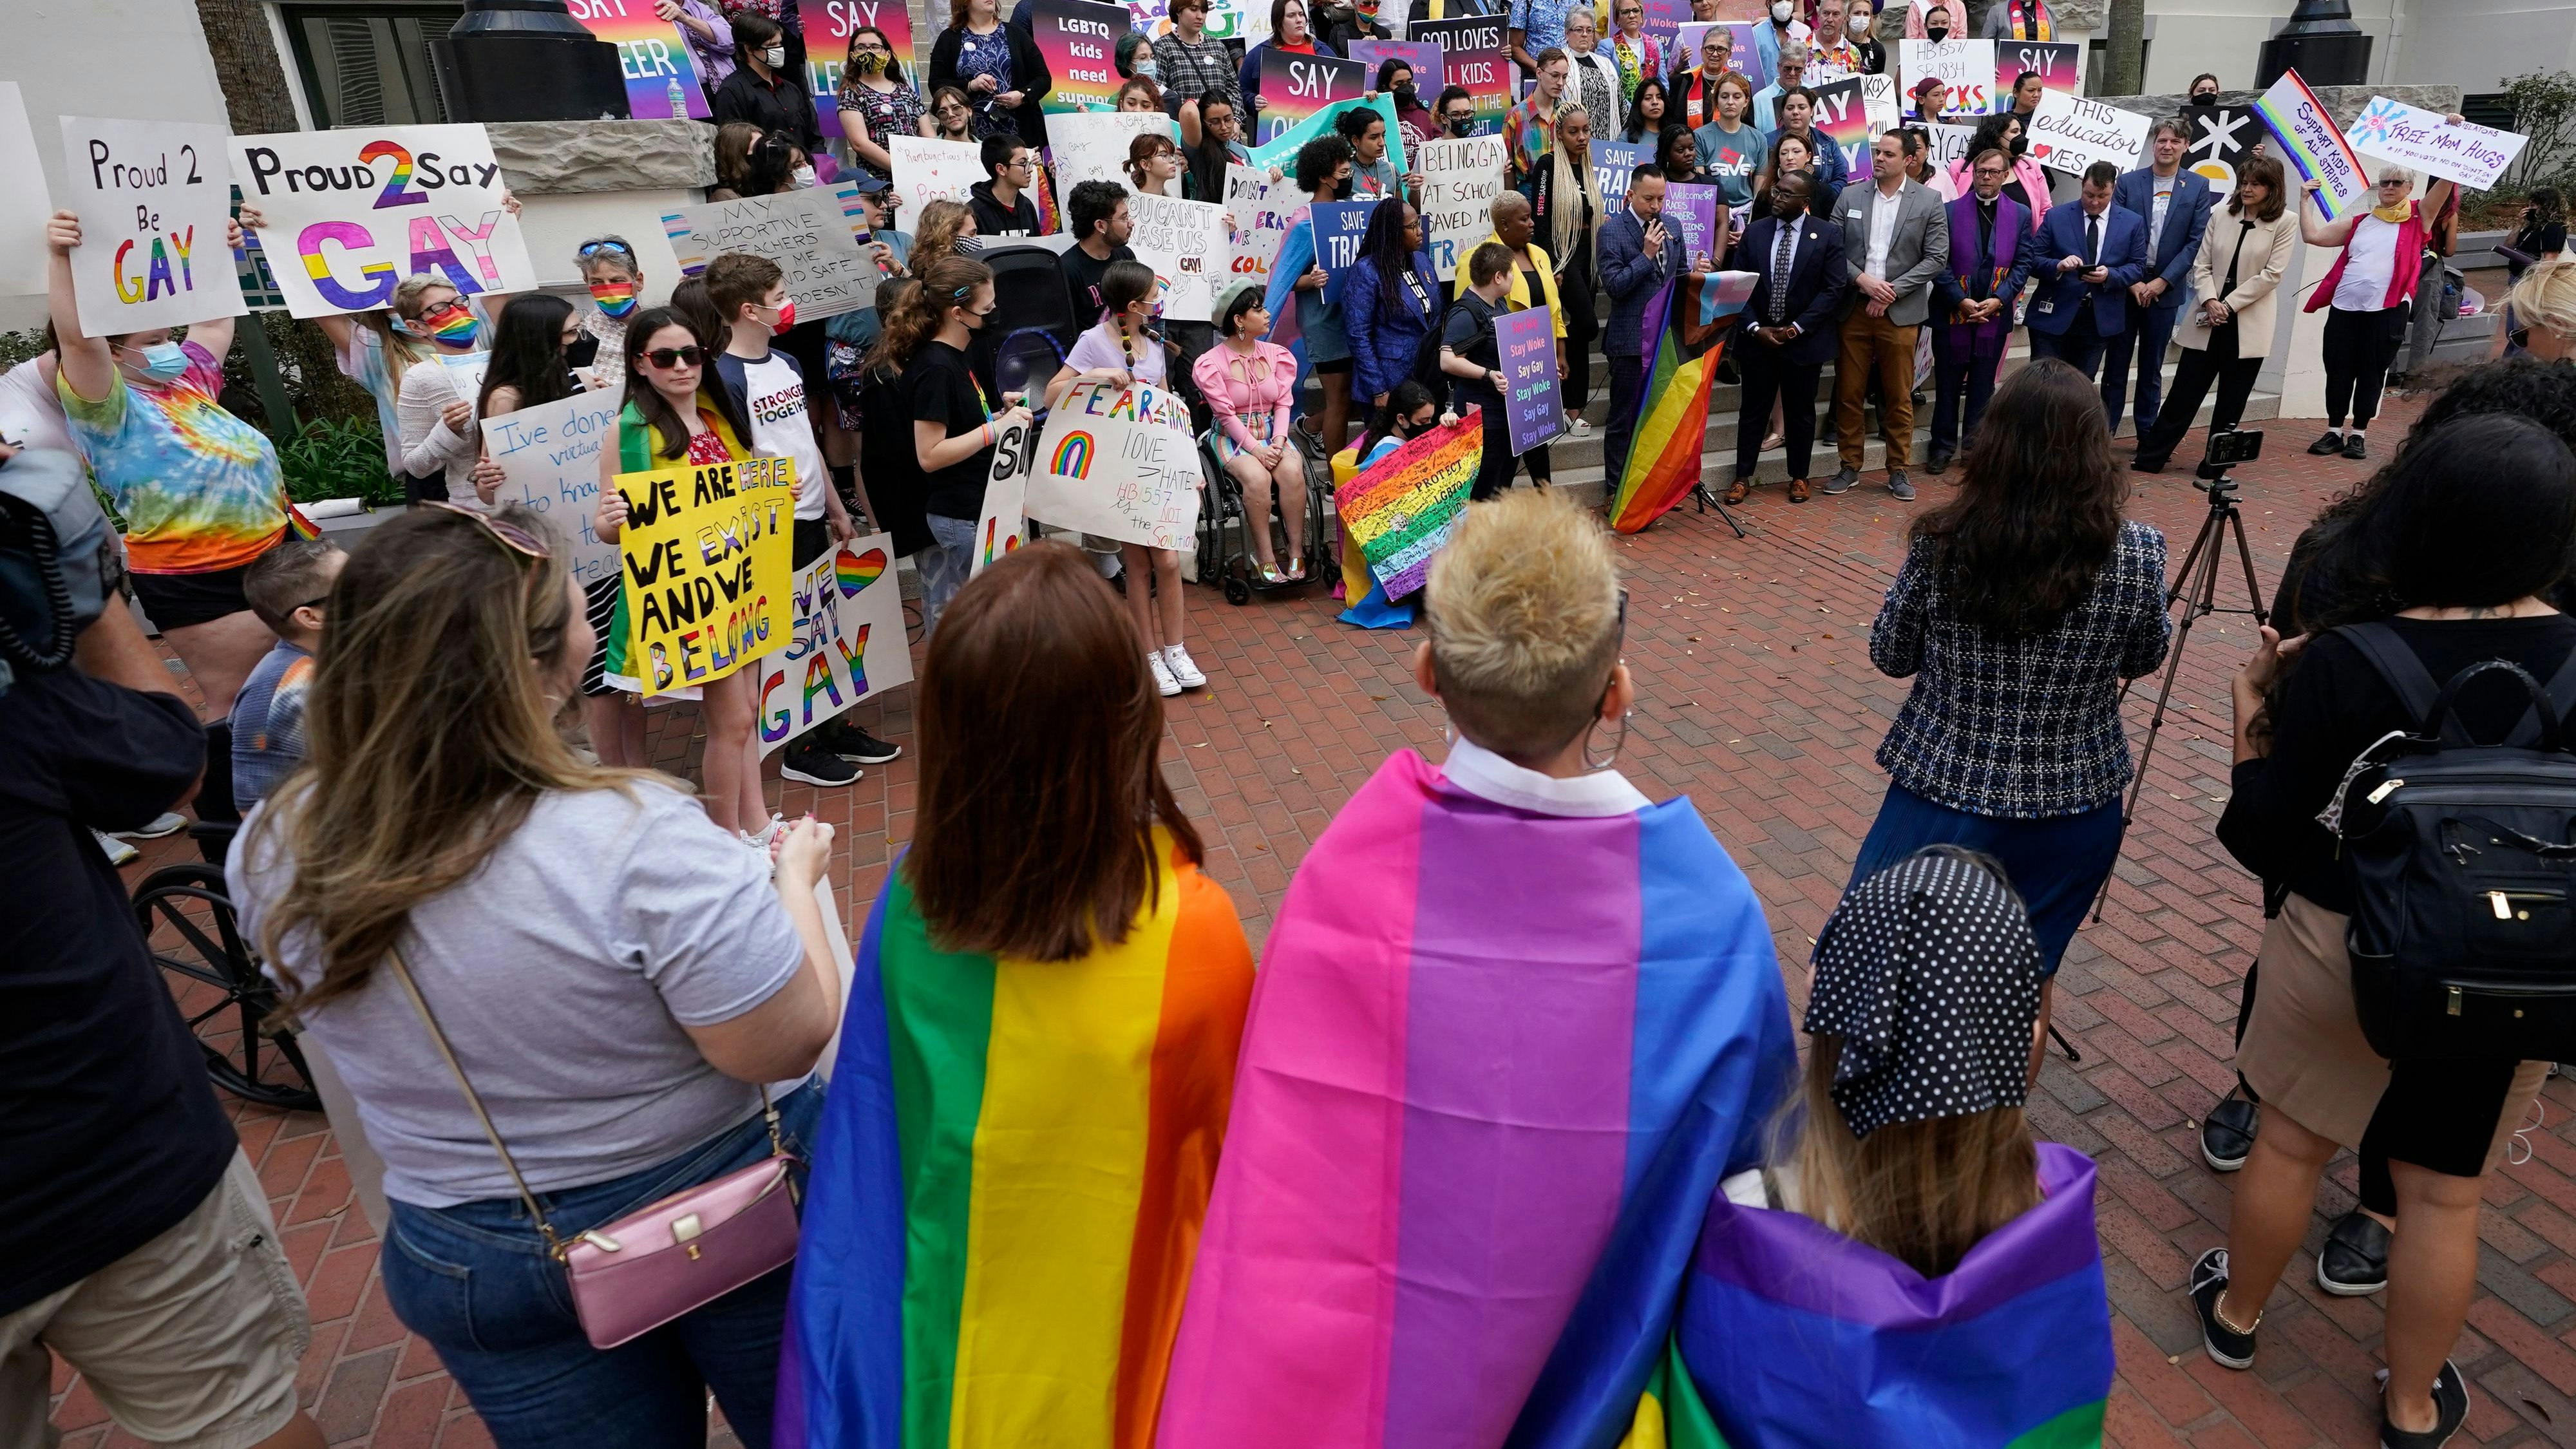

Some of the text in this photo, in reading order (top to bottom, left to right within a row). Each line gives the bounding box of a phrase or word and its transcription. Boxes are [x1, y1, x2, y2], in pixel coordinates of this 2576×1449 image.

[827, 1, 878, 37] SAY
[1058, 17, 1110, 40] LGBTQ
[1070, 42, 1103, 60] kids
[1375, 45, 1419, 59] Say Gay
[1455, 26, 1499, 52] LOVES
[616, 39, 678, 79] EER
[1461, 61, 1495, 84] KIDS,
[2018, 48, 2058, 77] SAY
[1069, 67, 1108, 84] need
[1288, 61, 1339, 100] SAY
[1057, 90, 1110, 104] suppor
[1482, 93, 1502, 109] THE
[1813, 90, 1852, 127] AY
[1905, 85, 1987, 116] SCKS
[2071, 97, 2116, 125] THIS
[2032, 115, 2141, 155] educator
[2445, 120, 2499, 137] GISLATORS
[1425, 141, 1504, 172] BEING GAY
[1605, 149, 1635, 167] SAVE
[2388, 120, 2505, 169] FREE MOM HUGS
[2419, 153, 2438, 162] VOTE
[89, 139, 202, 189] Proud 2
[358, 140, 430, 209] 2
[2295, 124, 2348, 198] OF ALL STRIPES
[2328, 149, 2350, 176] KIDS
[916, 183, 969, 205] Prote
[1422, 184, 1446, 205] AT
[1665, 200, 1688, 210] RACES
[1668, 184, 1704, 200] Welcome
[137, 205, 160, 232] Be
[723, 198, 772, 225] MY
[1127, 194, 1213, 230] OU CAN'T
[1255, 211, 1292, 231] ERAS
[1340, 211, 1367, 231] SAVE
[1425, 208, 1490, 232] SAVED M
[691, 213, 822, 251] SUPPORTIVE
[1131, 225, 1208, 254] RASE US
[1232, 230, 1251, 246] UR
[114, 225, 193, 305] GAY
[297, 211, 504, 310] GAY
[794, 251, 820, 266] ME
[1180, 257, 1202, 273] GAY!
[1231, 255, 1268, 274] COL
[1329, 235, 1365, 269] TRA
[782, 259, 857, 285] ND SAFE
[1512, 316, 1539, 336] Say Gay
[1510, 336, 1546, 358] Stay Woke
[1518, 359, 1544, 379] Say Gay
[753, 383, 803, 413] STRONGE
[1061, 382, 1153, 424] FEAR
[1516, 379, 1551, 402] Stay Woke
[562, 409, 616, 438] done
[756, 398, 807, 426] TOGETHE
[1524, 401, 1549, 422] Say Gay
[1522, 421, 1557, 446] Stay Woke
[1159, 465, 1195, 491] HATE
[1414, 459, 1462, 493] PROTECT
[524, 484, 550, 513] to
[618, 479, 681, 531] WE
[694, 466, 735, 507] ARE
[1130, 515, 1151, 529] the
[1160, 507, 1182, 523] NOT
[625, 538, 685, 589] WE
[793, 560, 835, 617] WE
[785, 598, 839, 661] SAY
[761, 623, 871, 743] GAY
